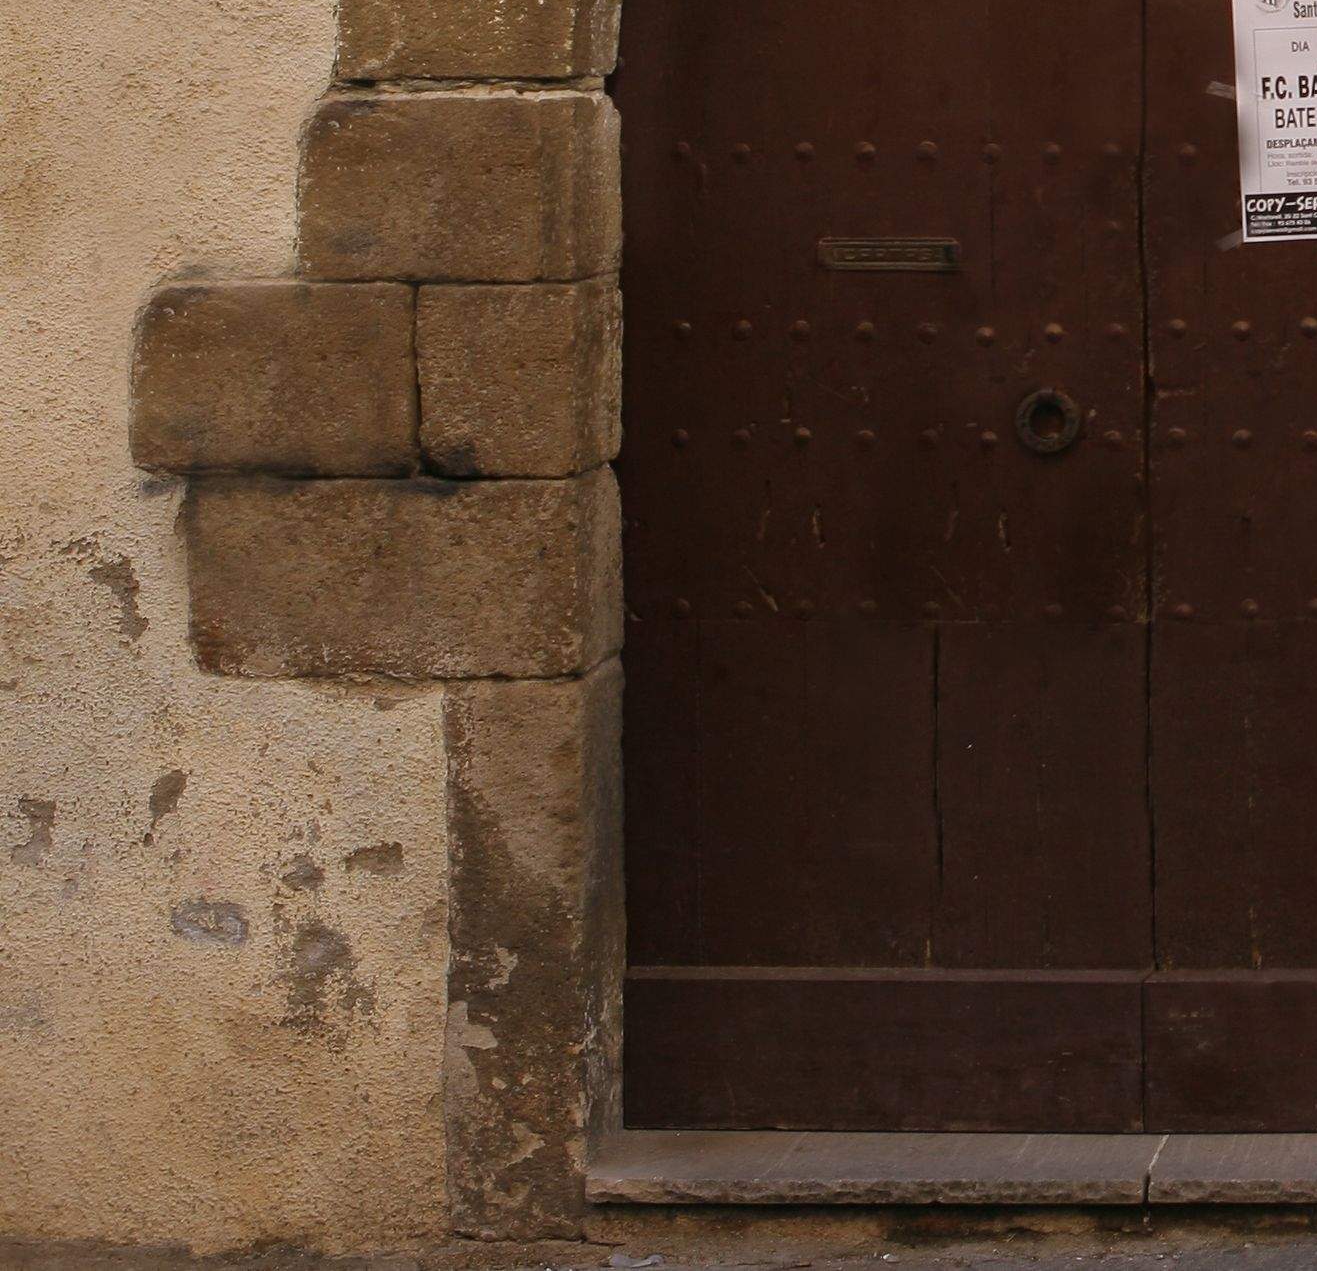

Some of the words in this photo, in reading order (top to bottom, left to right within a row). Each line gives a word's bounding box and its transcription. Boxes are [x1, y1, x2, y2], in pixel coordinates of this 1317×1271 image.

[1293, 1, 1317, 18] Sant
[1291, 41, 1310, 52] DIA
[1261, 75, 1292, 100] F.C.
[1275, 107, 1316, 128] BATE
